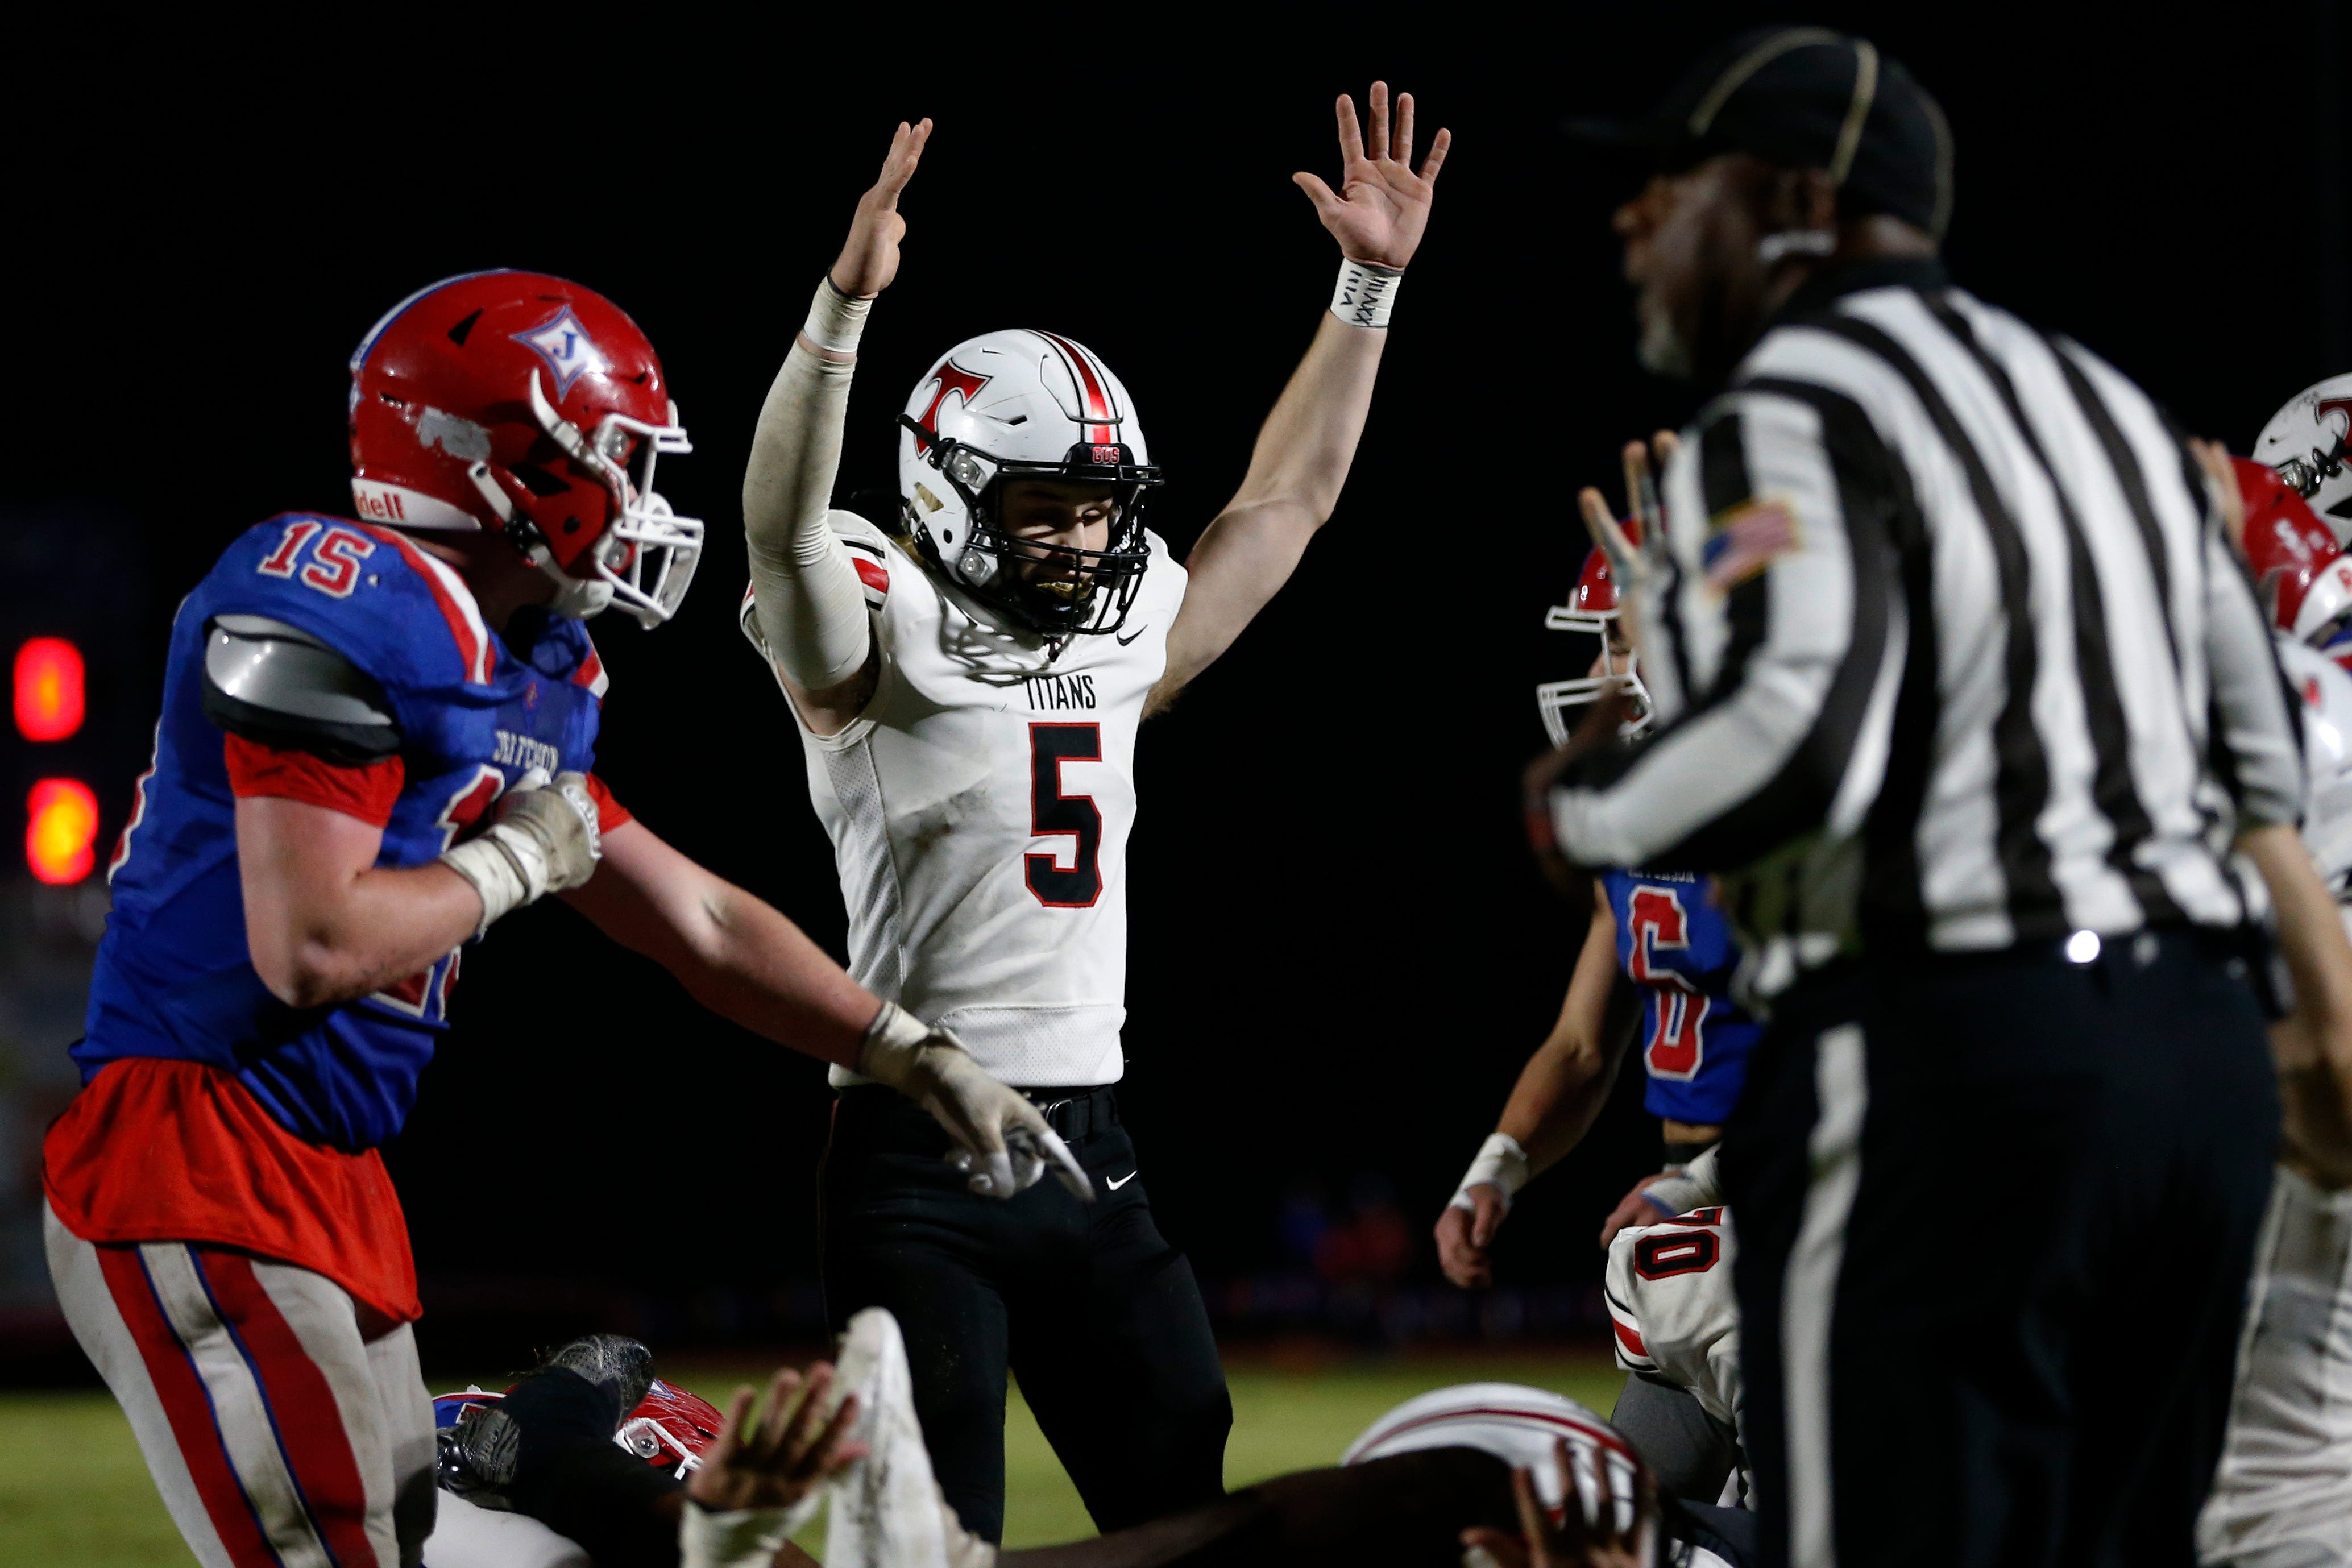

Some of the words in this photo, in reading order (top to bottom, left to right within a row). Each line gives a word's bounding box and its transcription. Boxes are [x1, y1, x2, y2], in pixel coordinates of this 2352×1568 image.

[1339, 269, 1362, 305] VIII
[553, 330, 578, 360] J
[257, 521, 376, 599] 15
[1022, 675, 1096, 710] TITANS
[1024, 722, 1103, 908] 5
[1628, 885, 1711, 1082] 6
